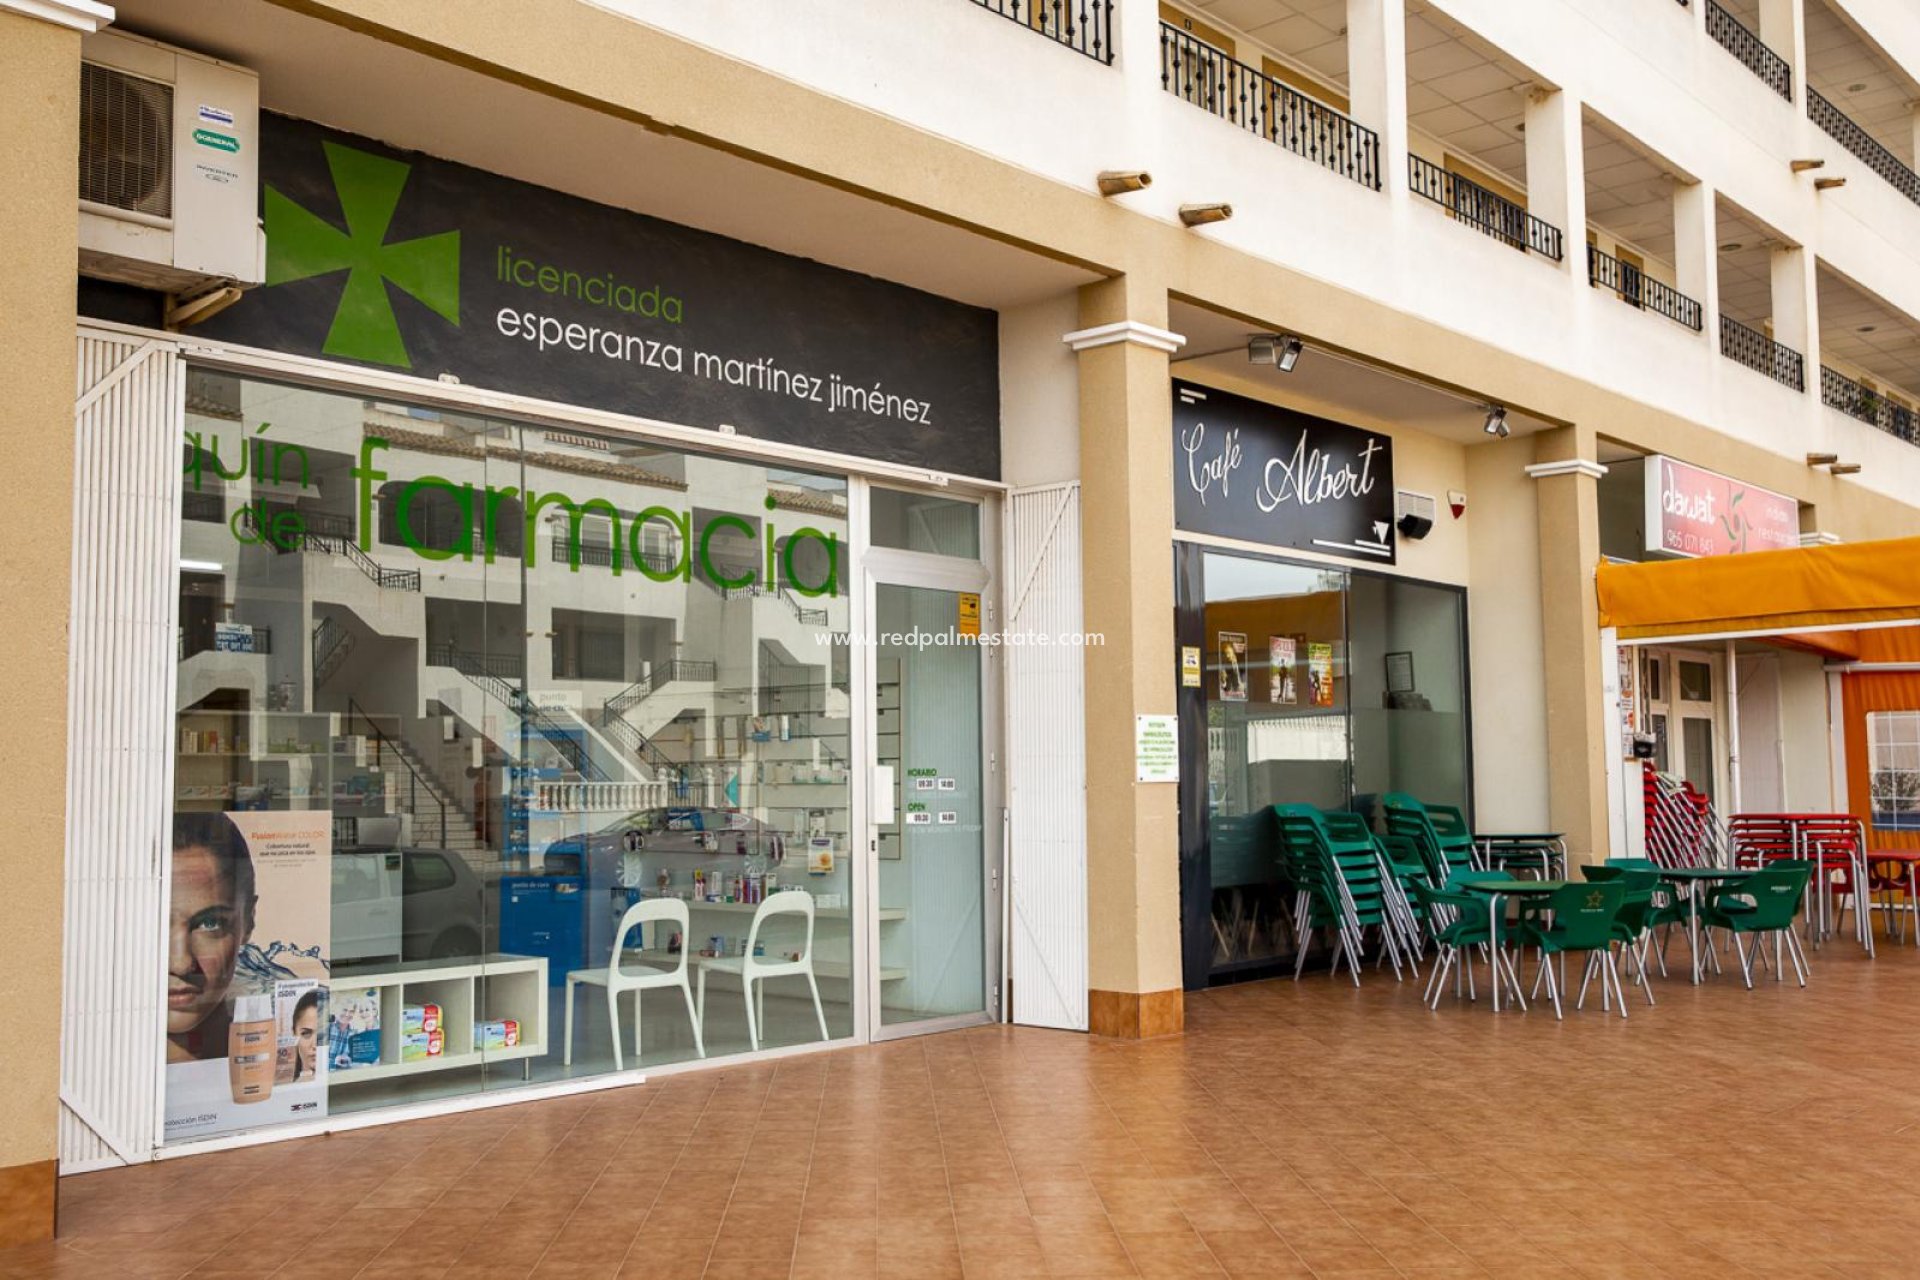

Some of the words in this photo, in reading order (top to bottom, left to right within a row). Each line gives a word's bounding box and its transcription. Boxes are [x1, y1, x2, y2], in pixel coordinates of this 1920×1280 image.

[497, 245, 683, 324] licenciada
[496, 307, 683, 373] esperanza
[693, 350, 823, 404] martínez
[828, 373, 932, 425] jiménez
[1181, 422, 1243, 507] Café
[1256, 428, 1383, 513] Albert
[1662, 463, 1716, 525] dawat
[229, 496, 306, 550] de
[350, 435, 838, 599] farmacia
